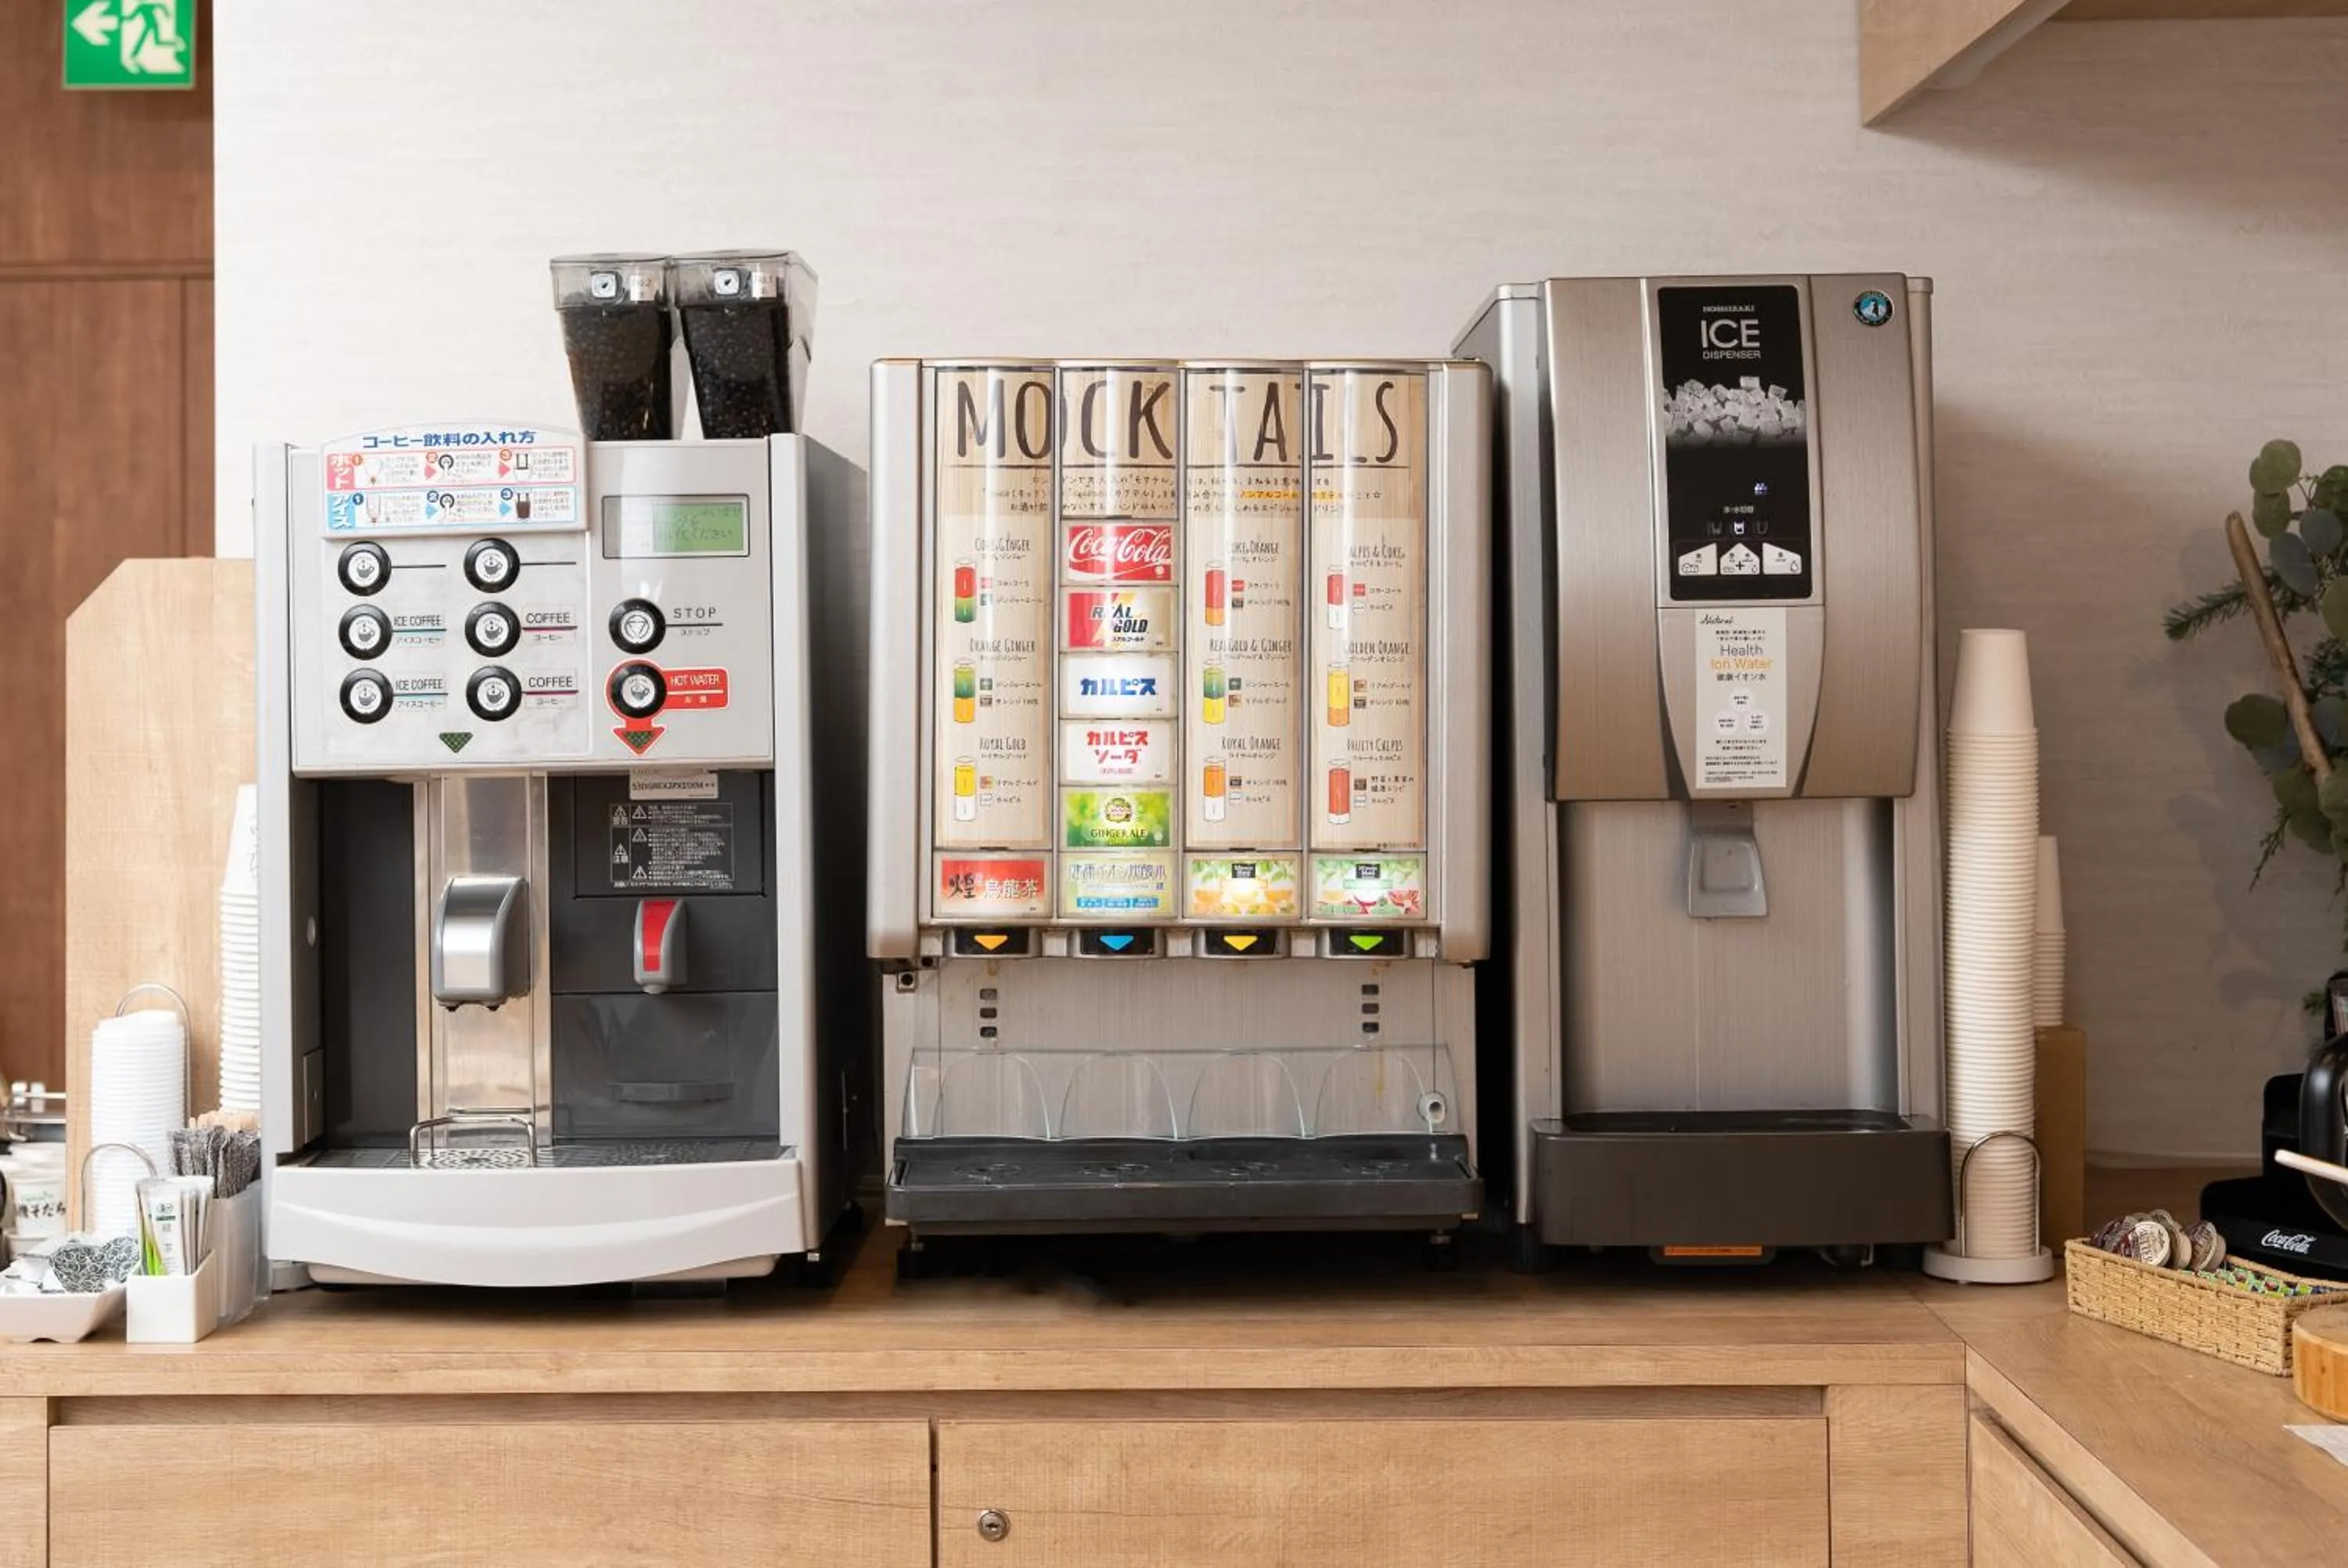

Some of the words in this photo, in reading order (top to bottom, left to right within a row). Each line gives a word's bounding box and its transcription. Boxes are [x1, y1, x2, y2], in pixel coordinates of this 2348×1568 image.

[1701, 318, 1760, 348] ICE
[1702, 350, 1761, 359] DISPENSER
[362, 430, 537, 449] コーヒー飲料の入れ方
[1069, 527, 1172, 563] Coca-Cola
[673, 607, 717, 619] STOP
[1091, 604, 1134, 619] RAL
[394, 615, 407, 627] ICE
[409, 614, 442, 626] COFFEE
[525, 613, 571, 624] COFFEE
[1112, 619, 1148, 633] GOLD
[1720, 644, 1763, 656] Health
[1711, 658, 1730, 671] Ion
[1733, 658, 1774, 671] Water
[528, 676, 573, 688] COFFEE
[671, 675, 688, 686] HOT
[690, 674, 719, 685] WATER
[1716, 672, 1766, 682] 健康イオン水
[395, 679, 409, 691] ICE
[411, 678, 444, 690] COFFEE
[1080, 678, 1156, 696] カルピス
[1086, 730, 1149, 746] カルピス
[1222, 735, 1247, 750] ROYAL
[1250, 735, 1280, 750] ORANGE
[1094, 747, 1143, 764] ソーダ
[1090, 829, 1128, 838] GINGER
[1129, 829, 1147, 838] ALE
[2261, 1228, 2317, 1254] Coca-Cola
